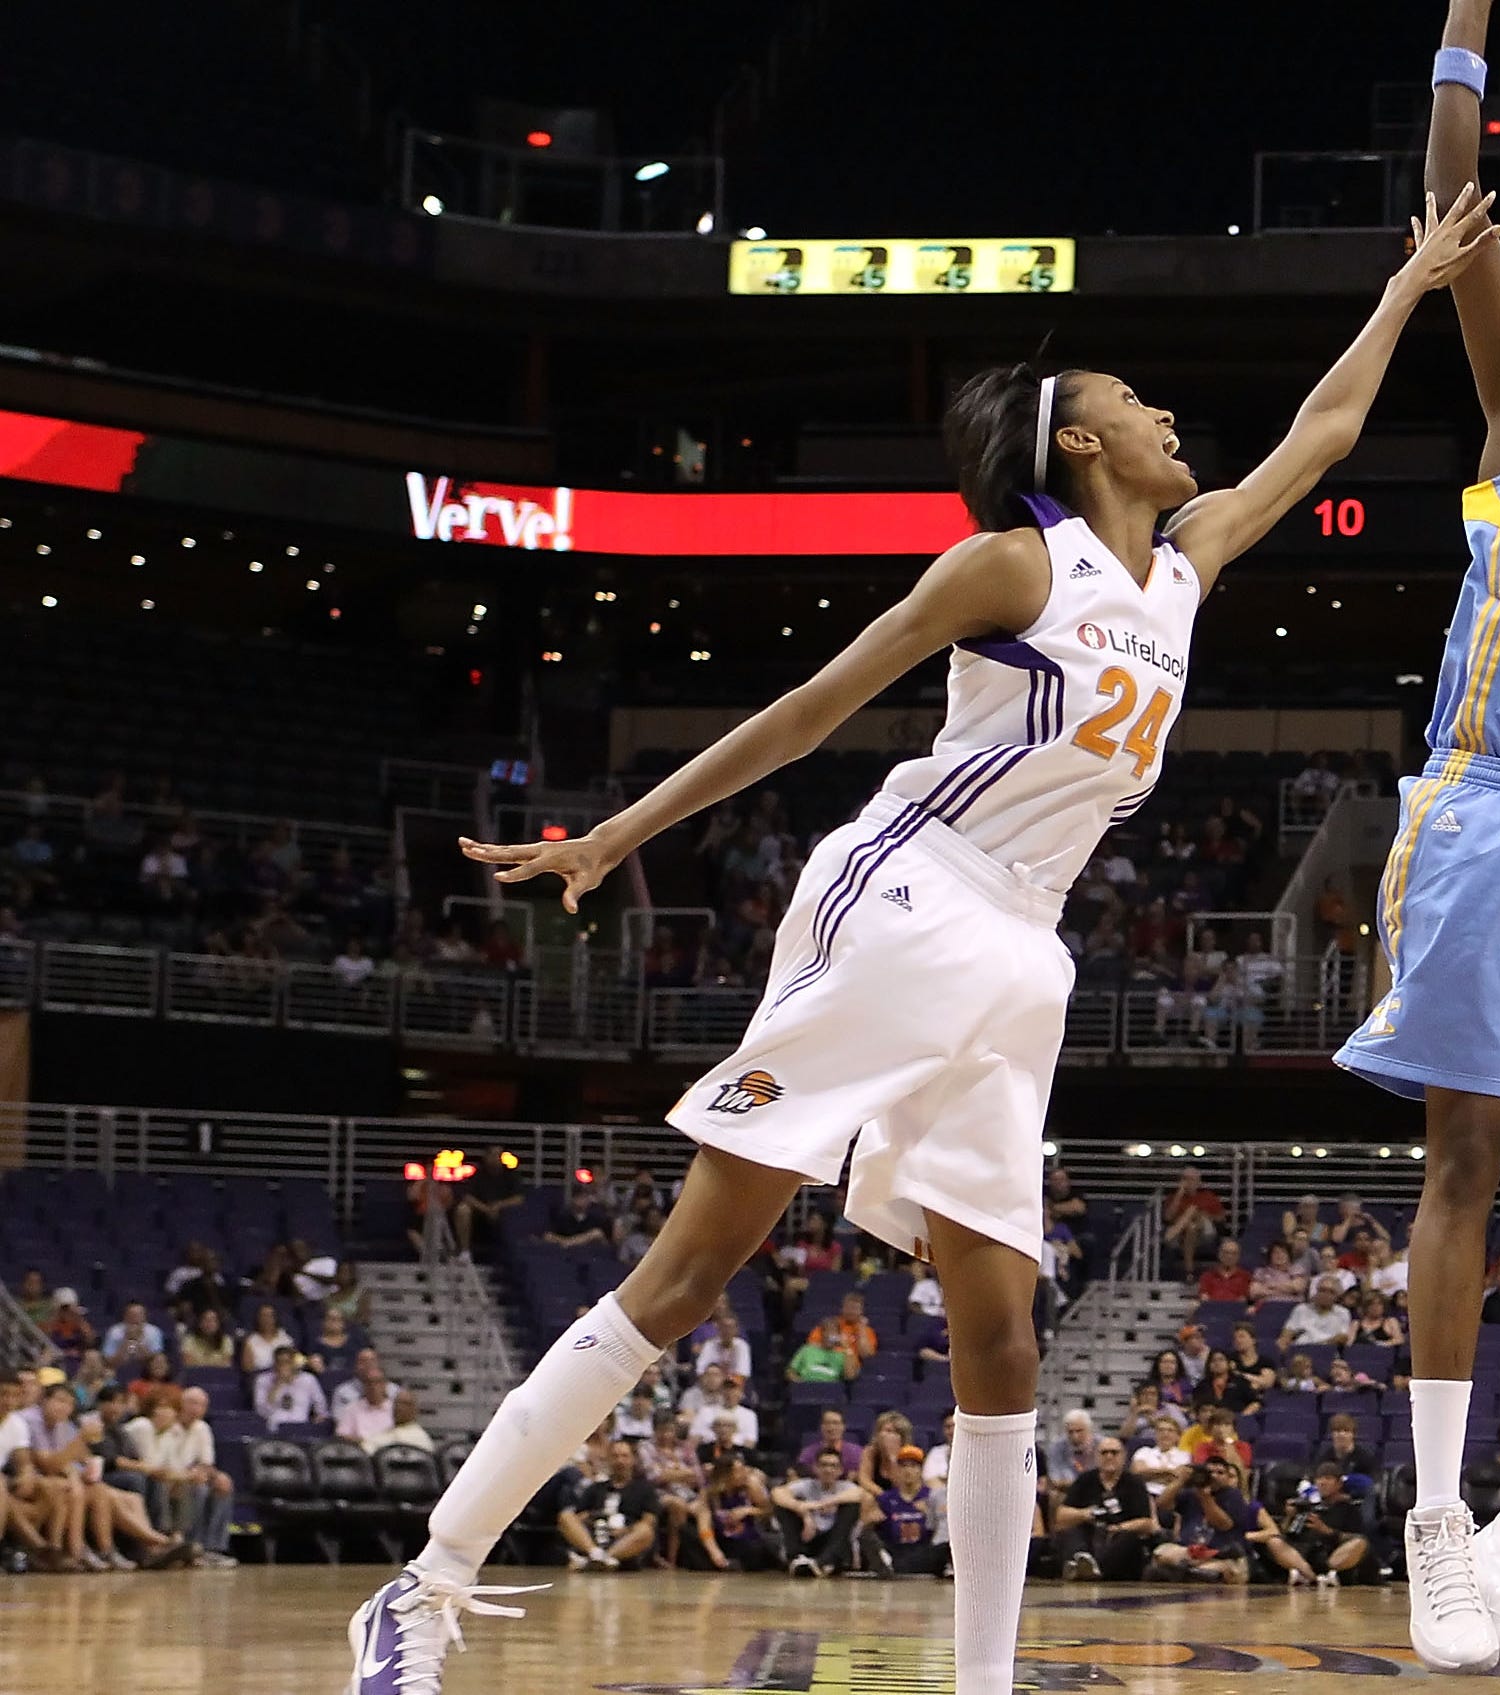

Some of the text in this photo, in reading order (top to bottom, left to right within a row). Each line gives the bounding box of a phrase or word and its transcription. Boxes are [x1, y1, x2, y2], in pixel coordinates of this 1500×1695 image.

[406, 471, 572, 552] Verve!
[1313, 498, 1365, 537] 10
[1108, 628, 1187, 683] LifeLock
[1069, 664, 1174, 781] 24
